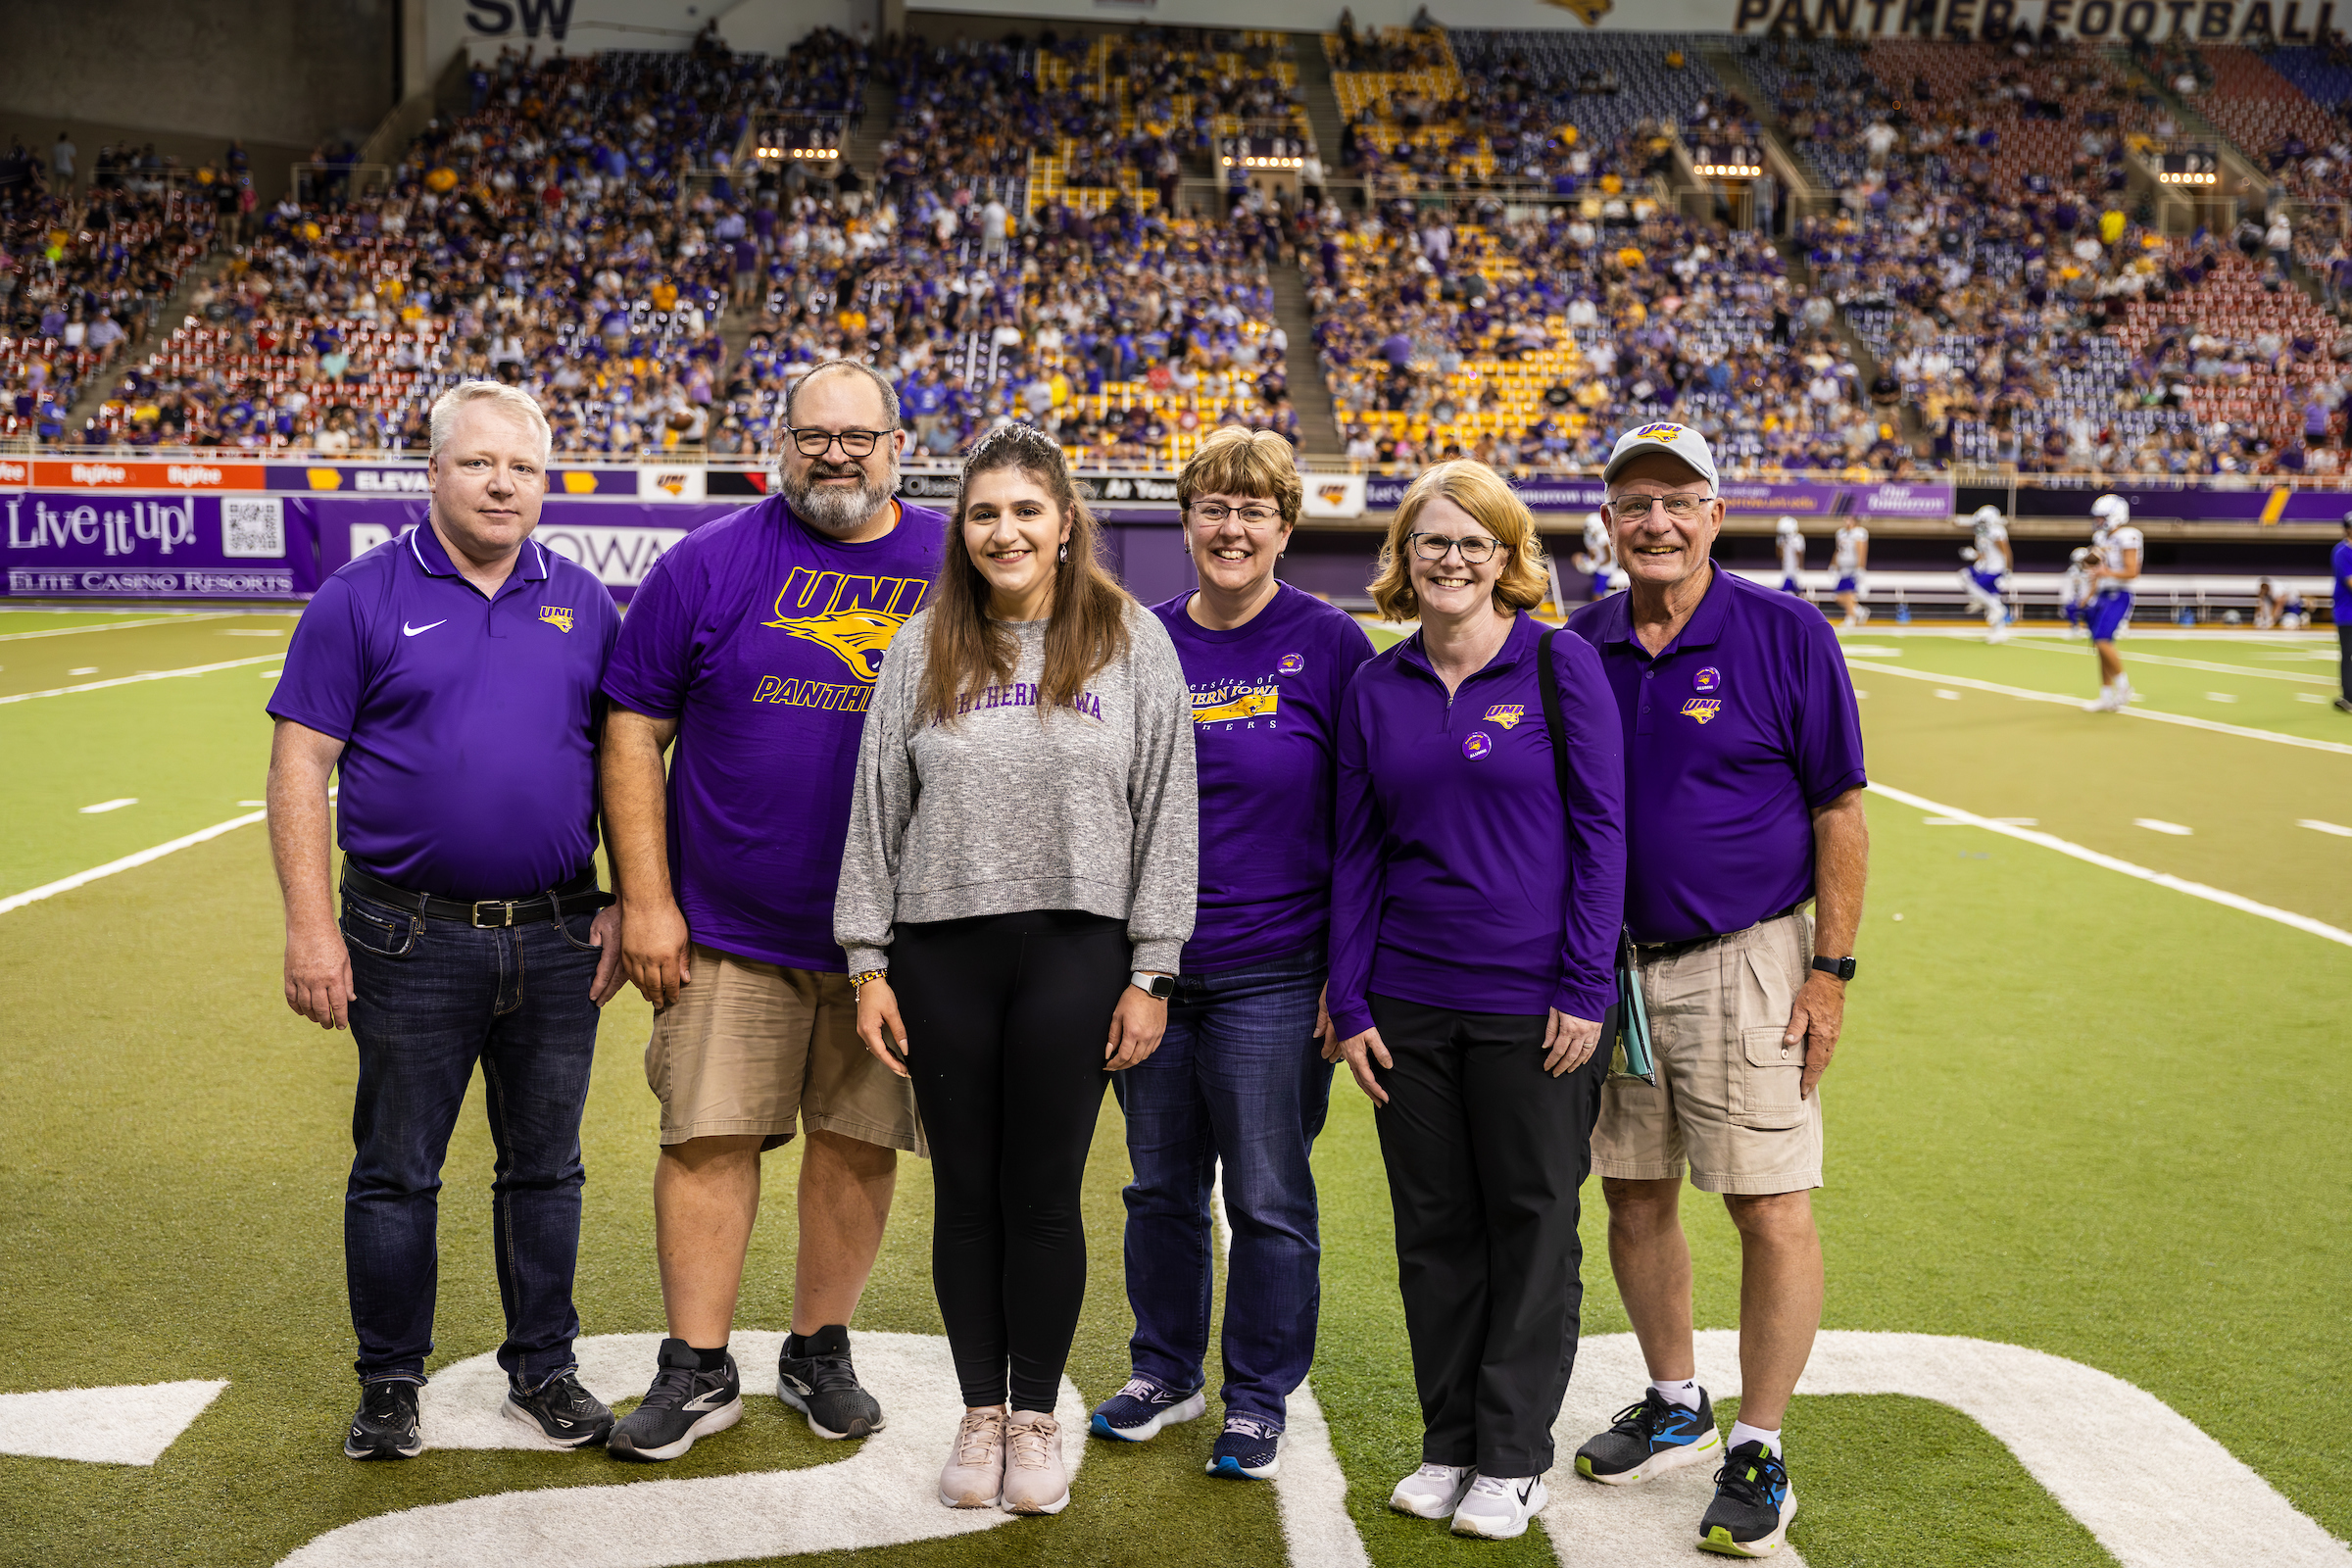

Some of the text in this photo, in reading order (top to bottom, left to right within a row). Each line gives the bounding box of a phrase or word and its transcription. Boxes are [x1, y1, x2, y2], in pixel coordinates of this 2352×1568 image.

[465, 0, 574, 41] SW
[1636, 423, 1684, 437] UNI
[355, 470, 429, 491] ELEVA
[6, 495, 197, 556] Live it up!
[530, 532, 665, 580] OWA
[9, 570, 294, 594] ELITE CASINO RESORTS
[774, 566, 929, 621] UNI
[540, 606, 573, 618] UNI
[1189, 673, 1275, 691] ersity of
[1231, 684, 1280, 698] IOWA
[753, 675, 875, 712] PANTH
[1485, 705, 1525, 717] UNI
[1683, 698, 1722, 712] UNI
